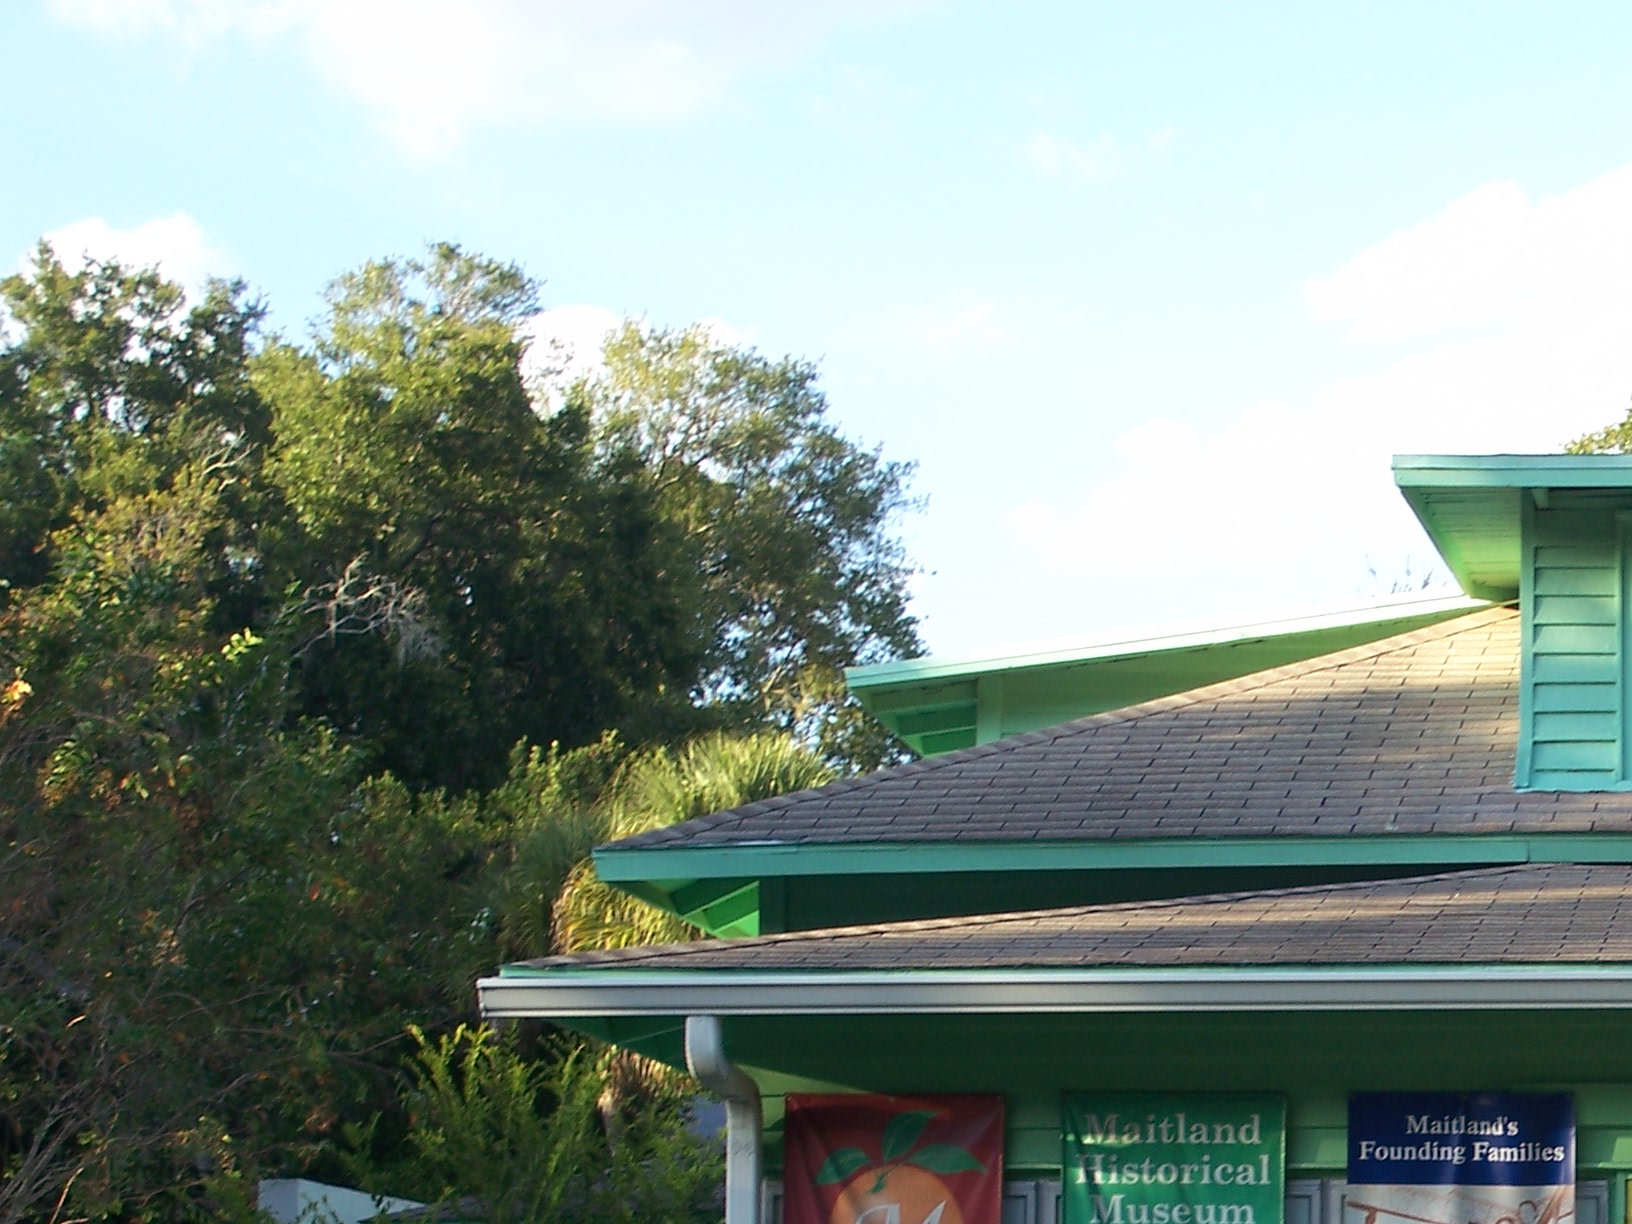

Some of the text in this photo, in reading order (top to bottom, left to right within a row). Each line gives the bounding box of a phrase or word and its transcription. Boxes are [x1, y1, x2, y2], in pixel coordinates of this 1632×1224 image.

[1082, 1112, 1262, 1145] Maitland
[1405, 1115, 1519, 1136] Maitland's
[1359, 1141, 1565, 1165] Founding Families
[1075, 1153, 1271, 1185] Historical
[1089, 1194, 1256, 1224] Museum
